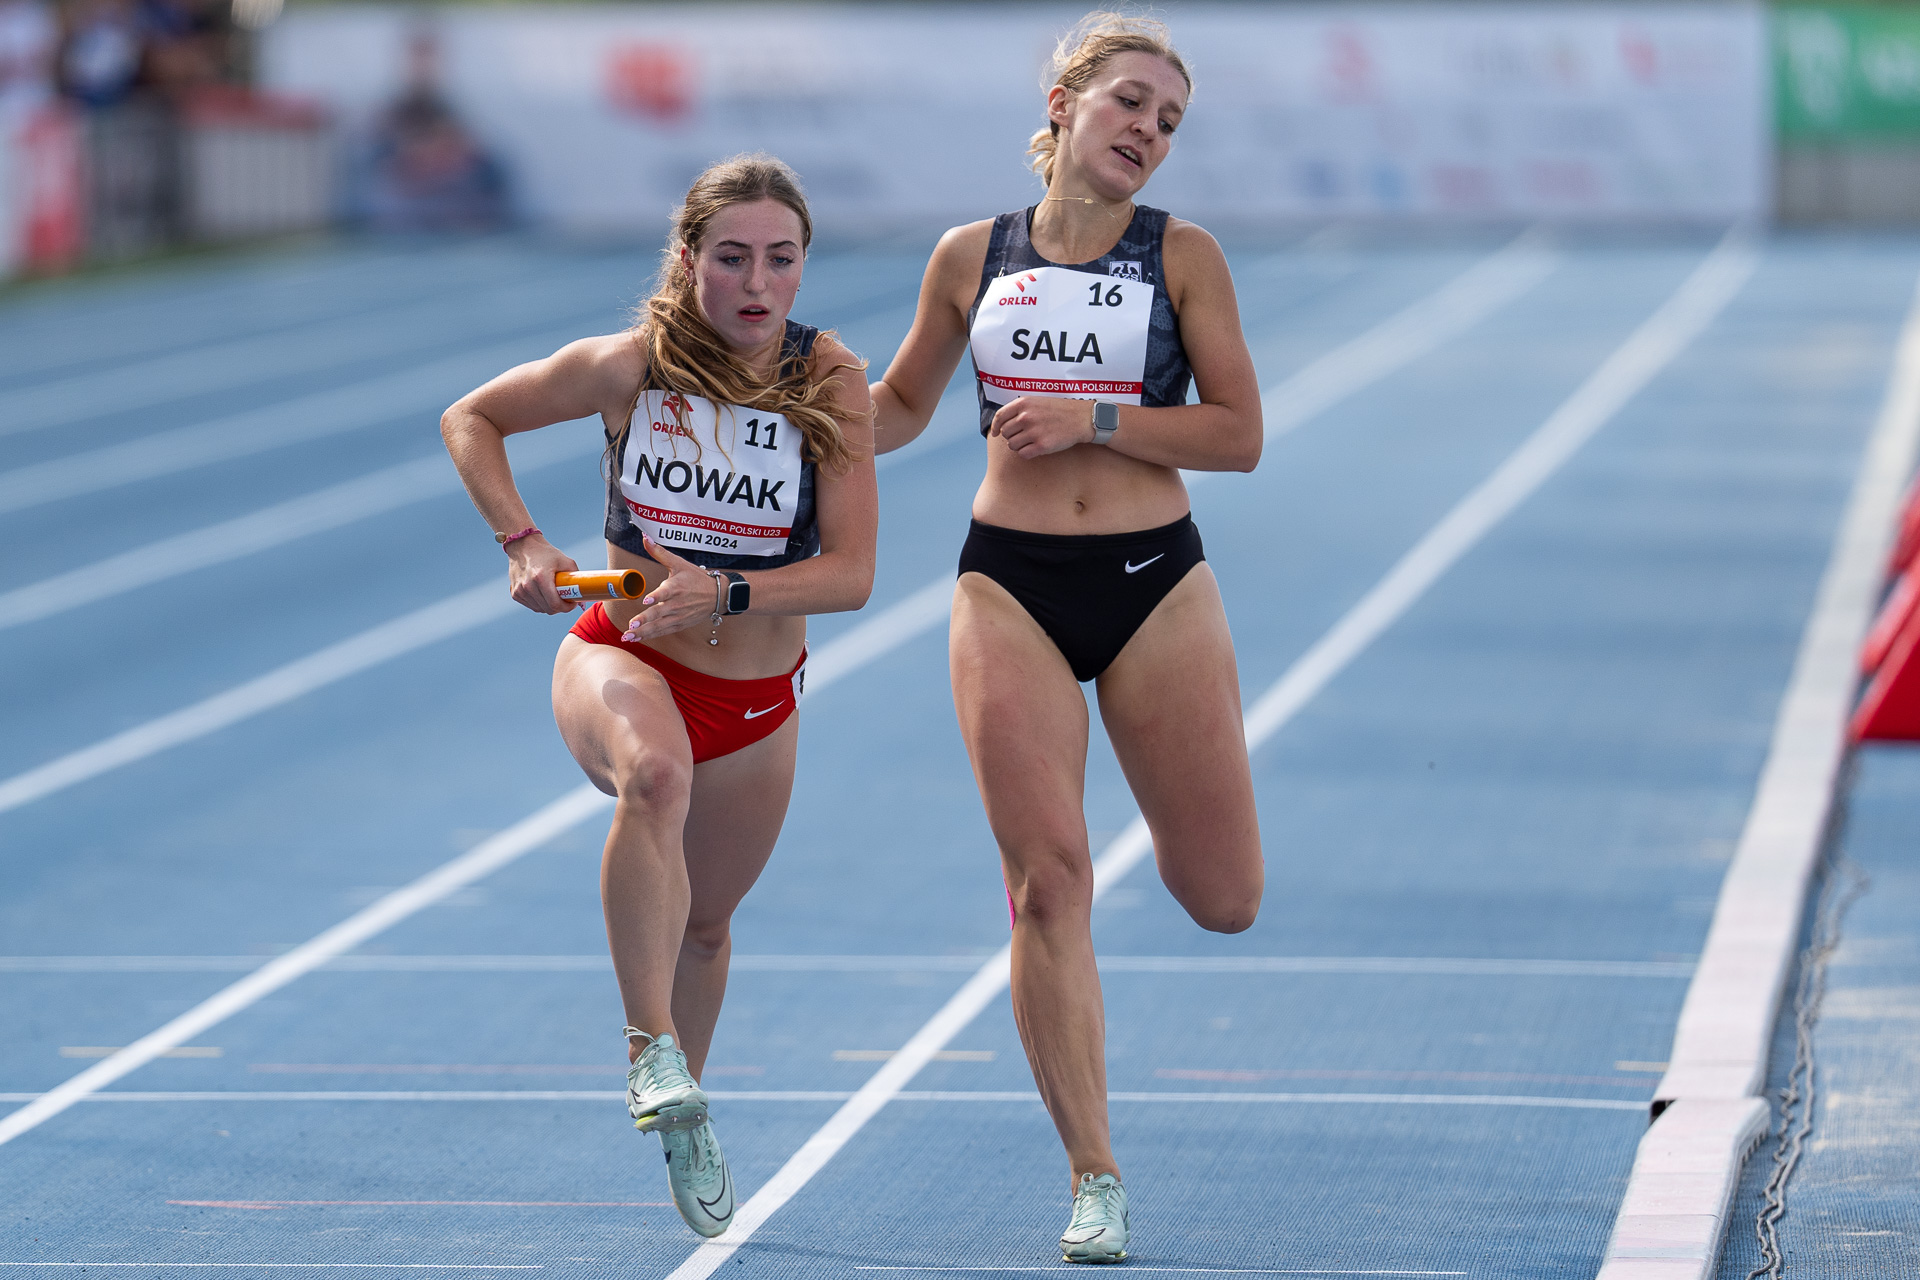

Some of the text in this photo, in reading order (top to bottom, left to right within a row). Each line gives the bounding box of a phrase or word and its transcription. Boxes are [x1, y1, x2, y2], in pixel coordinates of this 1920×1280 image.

[998, 296, 1037, 306] ORLEN
[1088, 282, 1123, 307] 16
[1010, 328, 1103, 364] SALA
[995, 378, 1014, 388] PZLA
[1015, 381, 1080, 392] MISTRZOSTWA
[1082, 382, 1113, 392] POLSKI
[1115, 383, 1133, 392] U23
[744, 418, 778, 451] 11
[634, 453, 785, 512] NOWAK
[638, 506, 657, 519] PZLA
[659, 509, 727, 532] MISTRZOSTWA
[729, 524, 761, 536] POLSKI
[763, 528, 781, 537] U23
[658, 528, 738, 549] LUBLIN 2024
